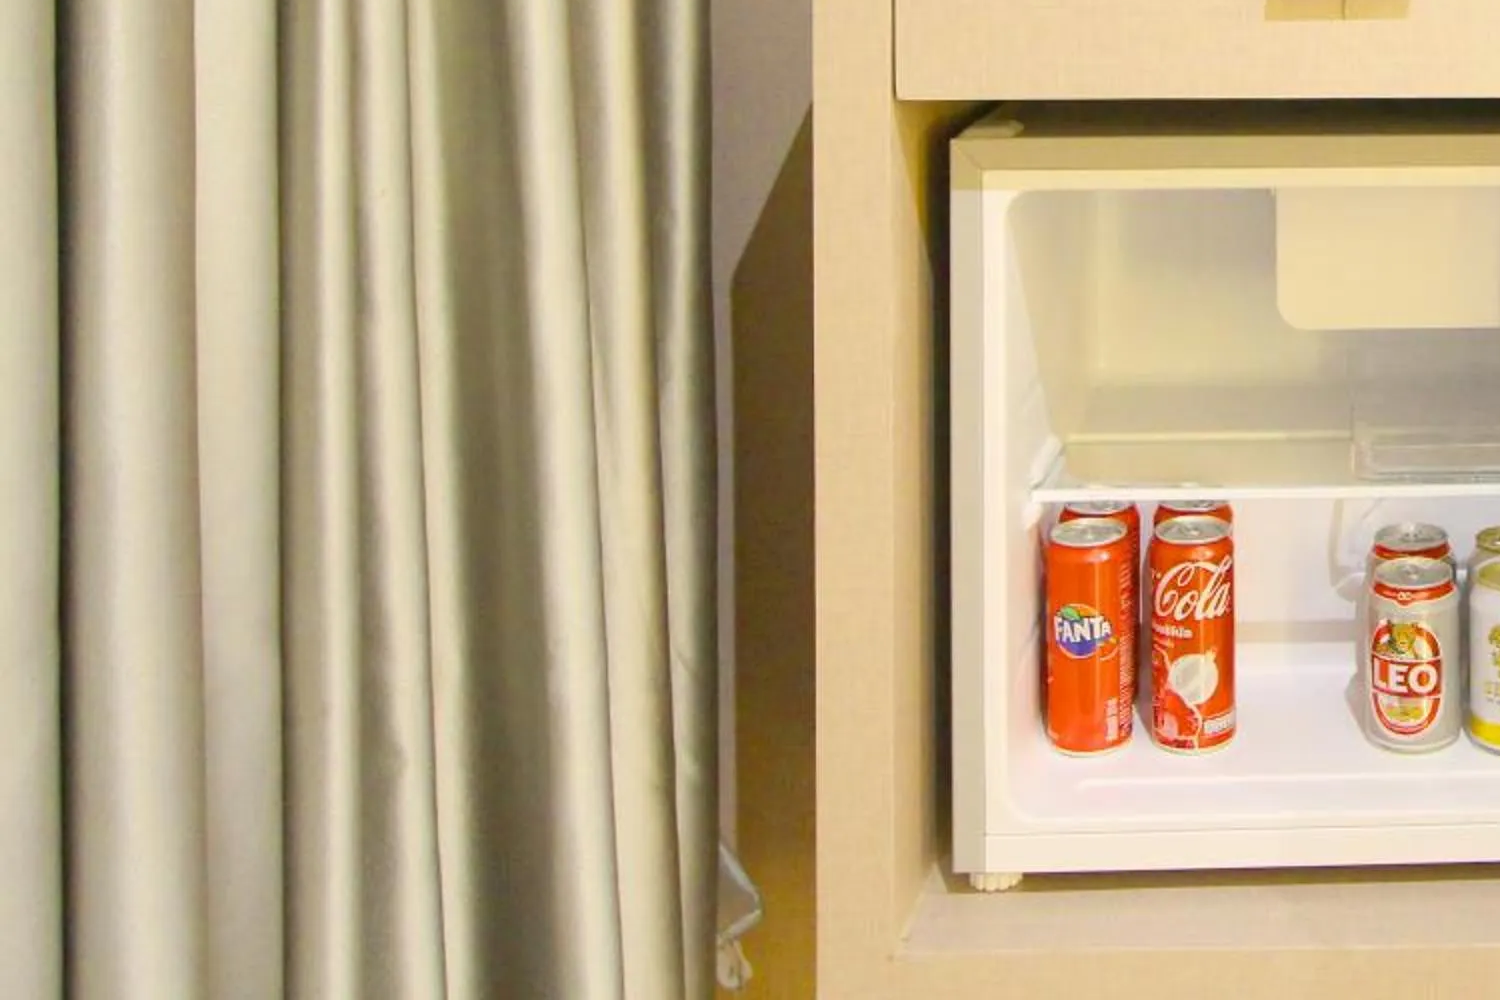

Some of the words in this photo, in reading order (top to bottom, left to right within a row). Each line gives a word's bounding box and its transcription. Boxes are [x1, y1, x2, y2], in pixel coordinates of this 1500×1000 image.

[1155, 555, 1233, 622] Cola
[1054, 615, 1112, 643] FANTA
[1373, 658, 1438, 694] LEO
